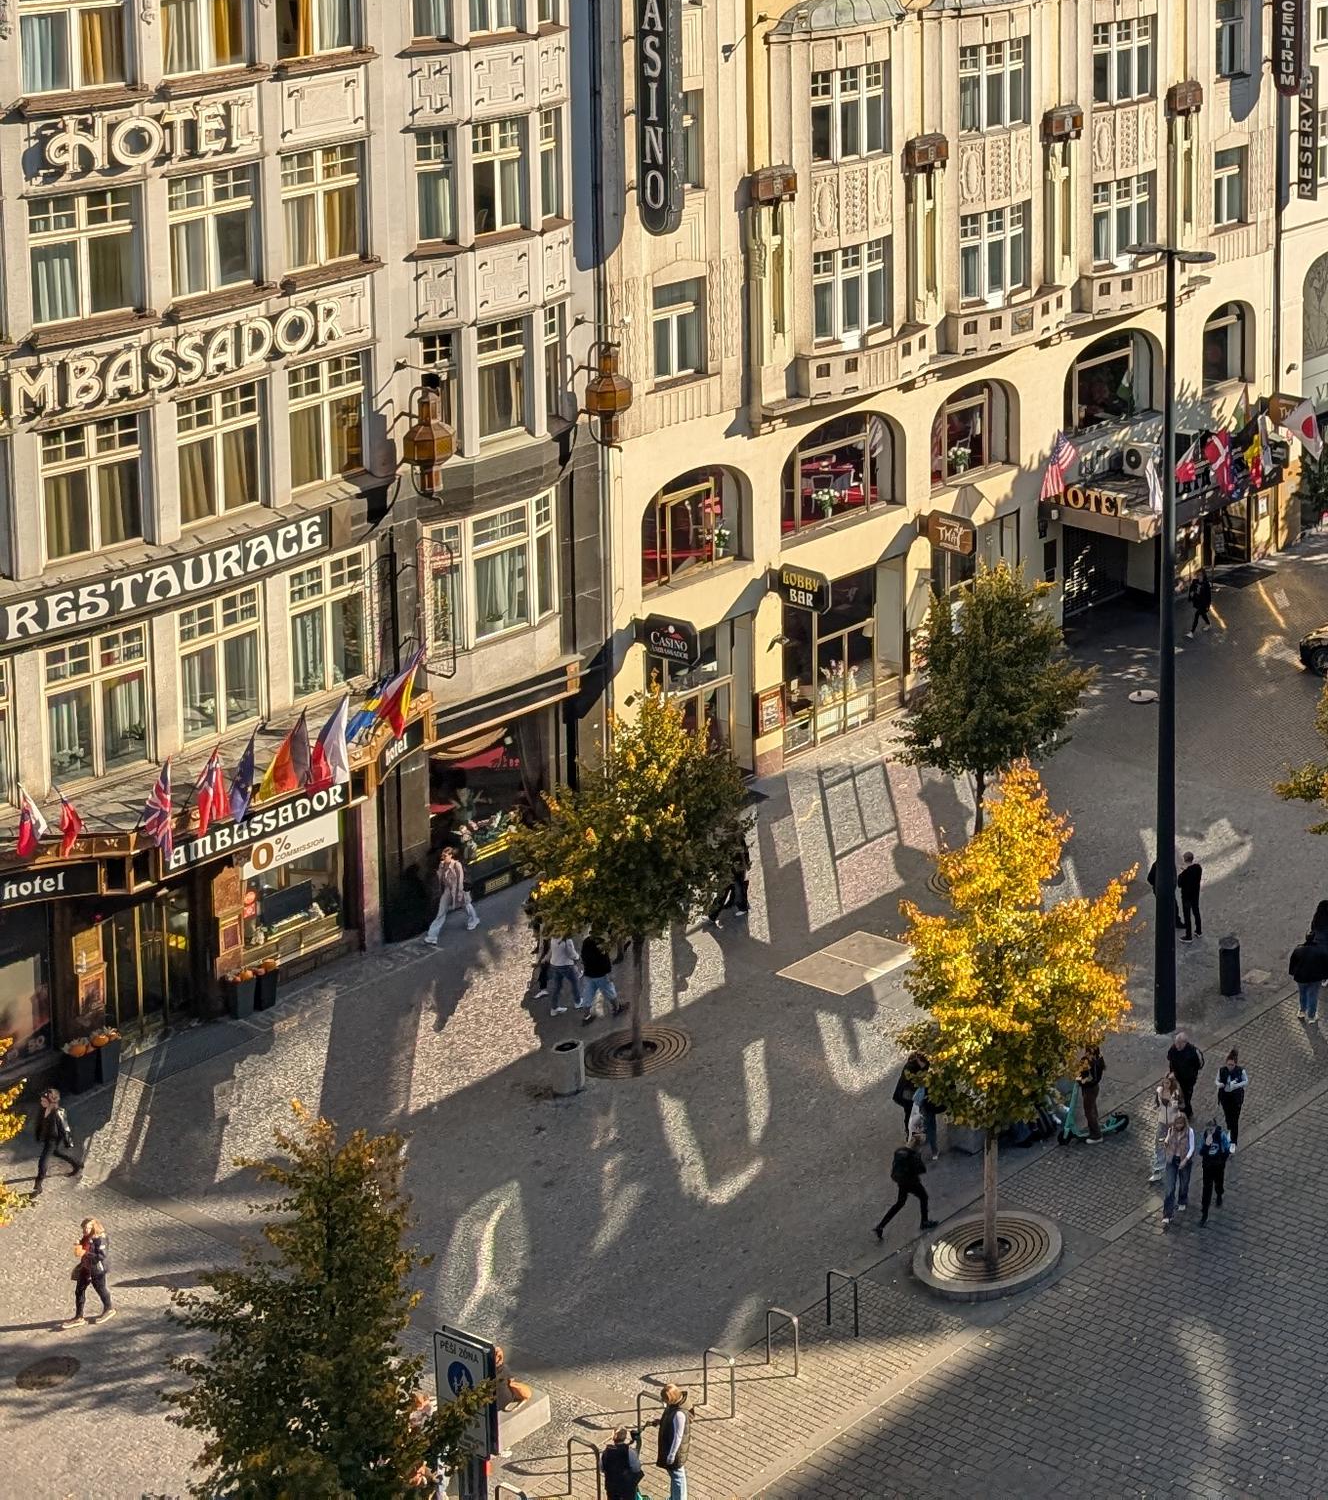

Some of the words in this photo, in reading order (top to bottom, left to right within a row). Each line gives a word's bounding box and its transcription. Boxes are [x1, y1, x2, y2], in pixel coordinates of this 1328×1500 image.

[1280, 2, 1296, 86] CENTRUM
[46, 100, 262, 174] HOTEL
[0, 299, 344, 419] MBASSADOR
[5, 516, 322, 640] RESTAURACE
[782, 570, 820, 592] LOBBY
[789, 588, 814, 607] BAR
[650, 631, 688, 652] CASINO
[169, 785, 344, 870] AMBASSADOR
[275, 837, 325, 861] COMMISSION
[3, 872, 65, 900] hotel
